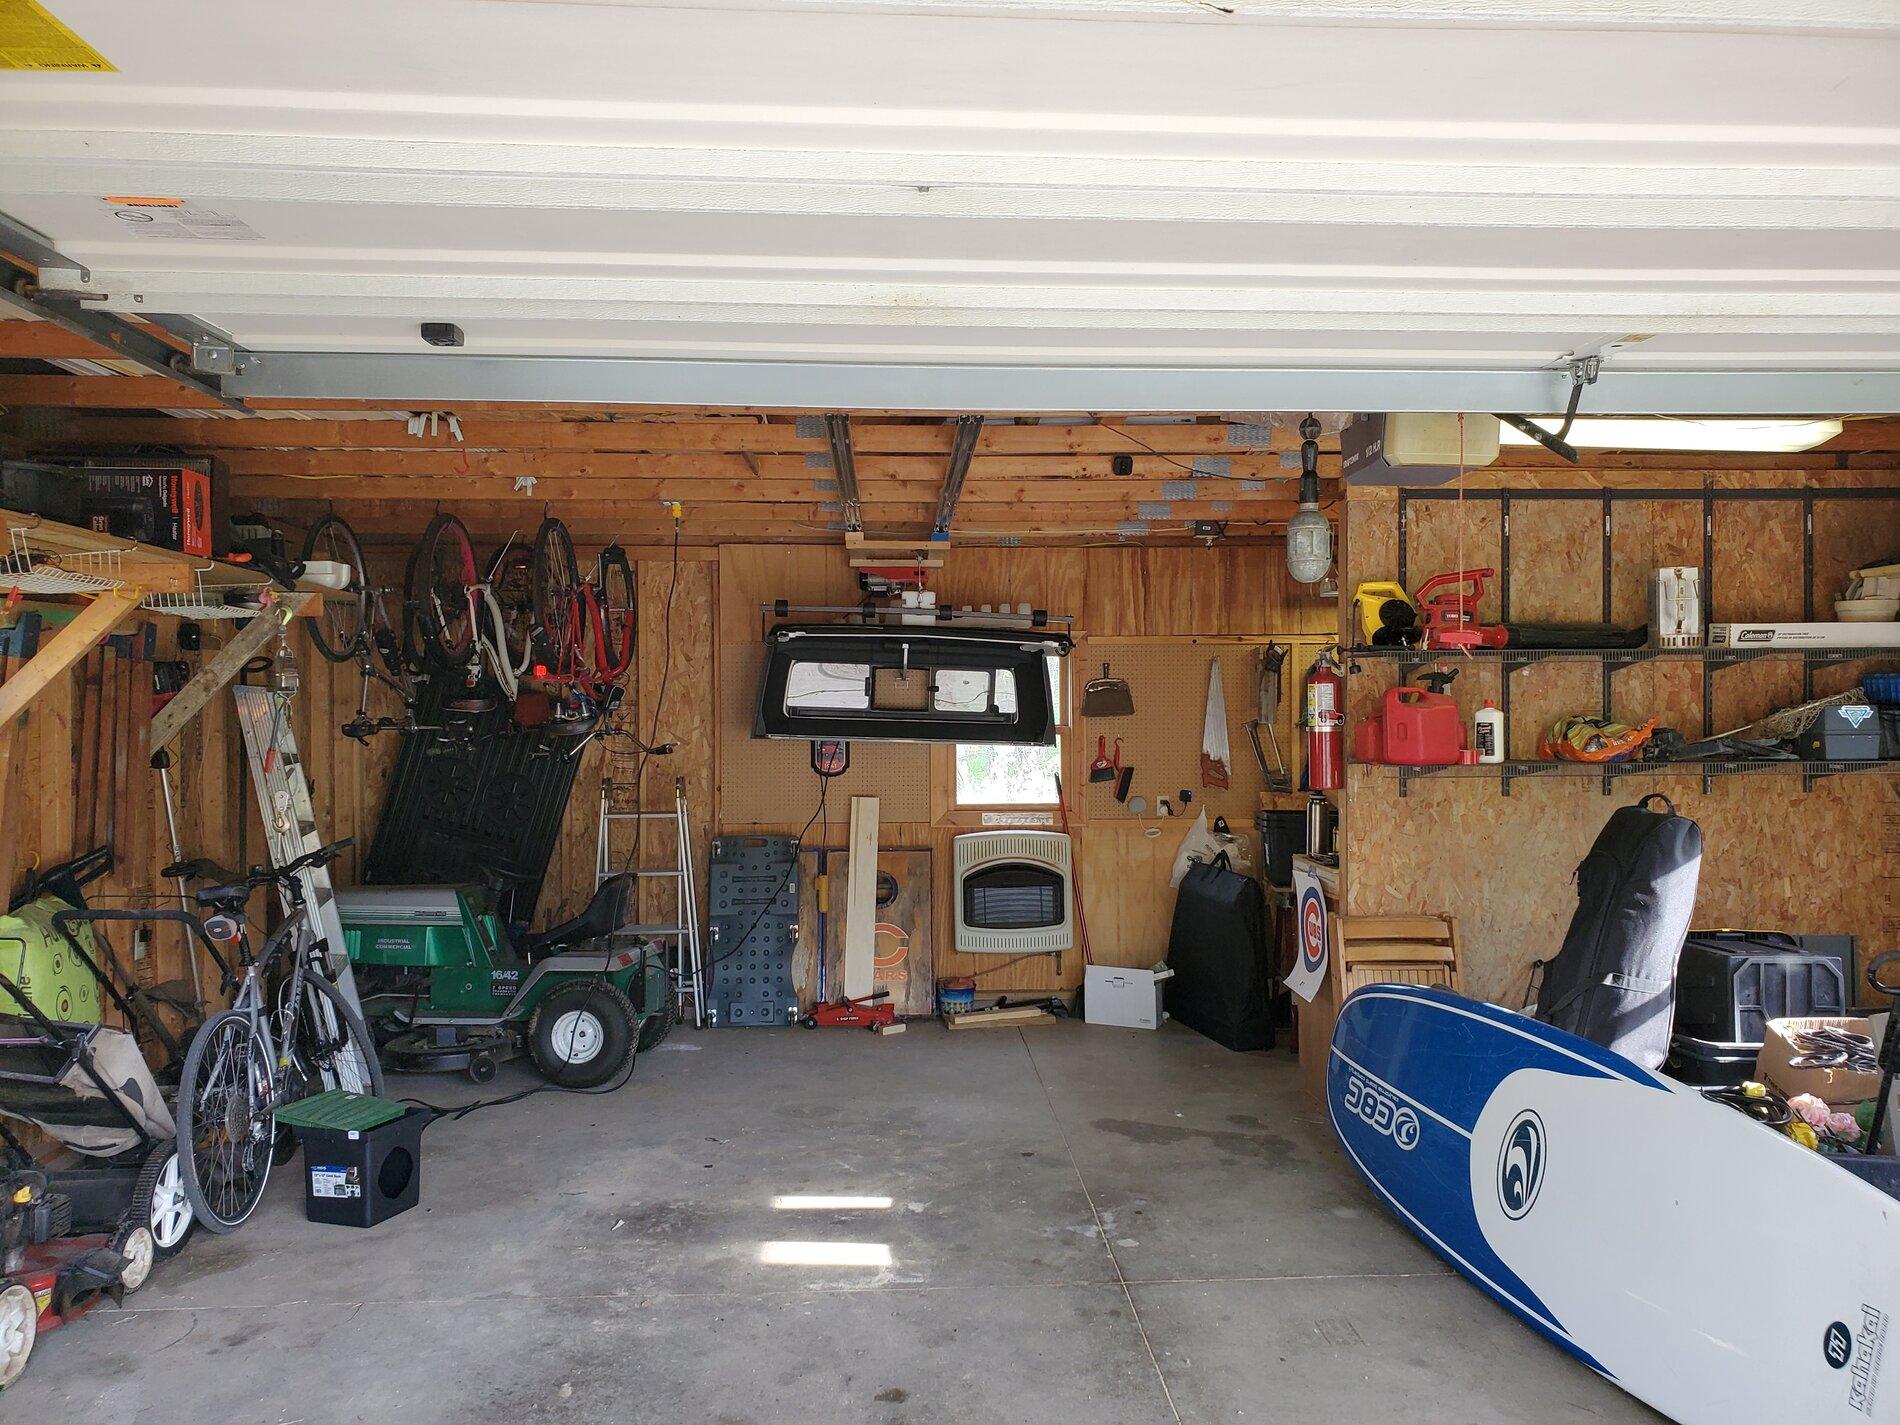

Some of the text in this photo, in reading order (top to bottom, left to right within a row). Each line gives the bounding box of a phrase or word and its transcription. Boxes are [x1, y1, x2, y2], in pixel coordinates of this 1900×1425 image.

[170, 475, 179, 514] Honeywell
[1741, 630, 1768, 640] Coleman
[875, 970, 908, 981] ARS
